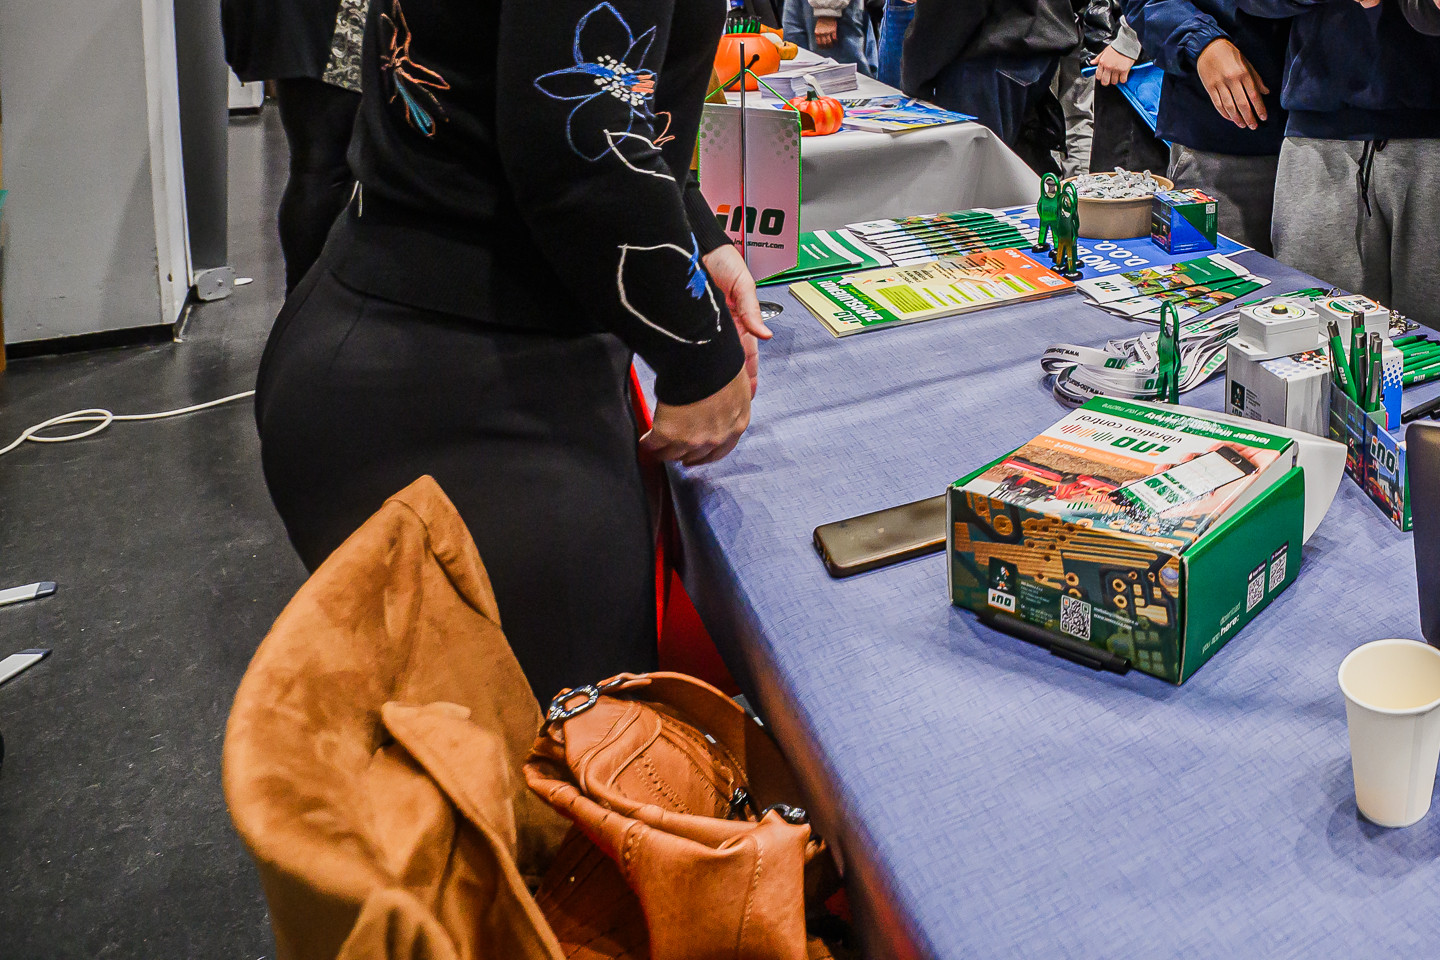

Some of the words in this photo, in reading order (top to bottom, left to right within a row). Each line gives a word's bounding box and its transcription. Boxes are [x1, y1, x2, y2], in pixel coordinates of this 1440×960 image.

[716, 204, 785, 236] ino
[1094, 240, 1150, 267] D.O.O.
[1201, 353, 1226, 375] ino
[1076, 414, 1123, 429] control
[1125, 425, 1183, 444] vibration
[1233, 432, 1271, 445] longer
[1110, 436, 1171, 456] ino
[1371, 435, 1396, 475] ino
[991, 592, 1012, 607] ino
